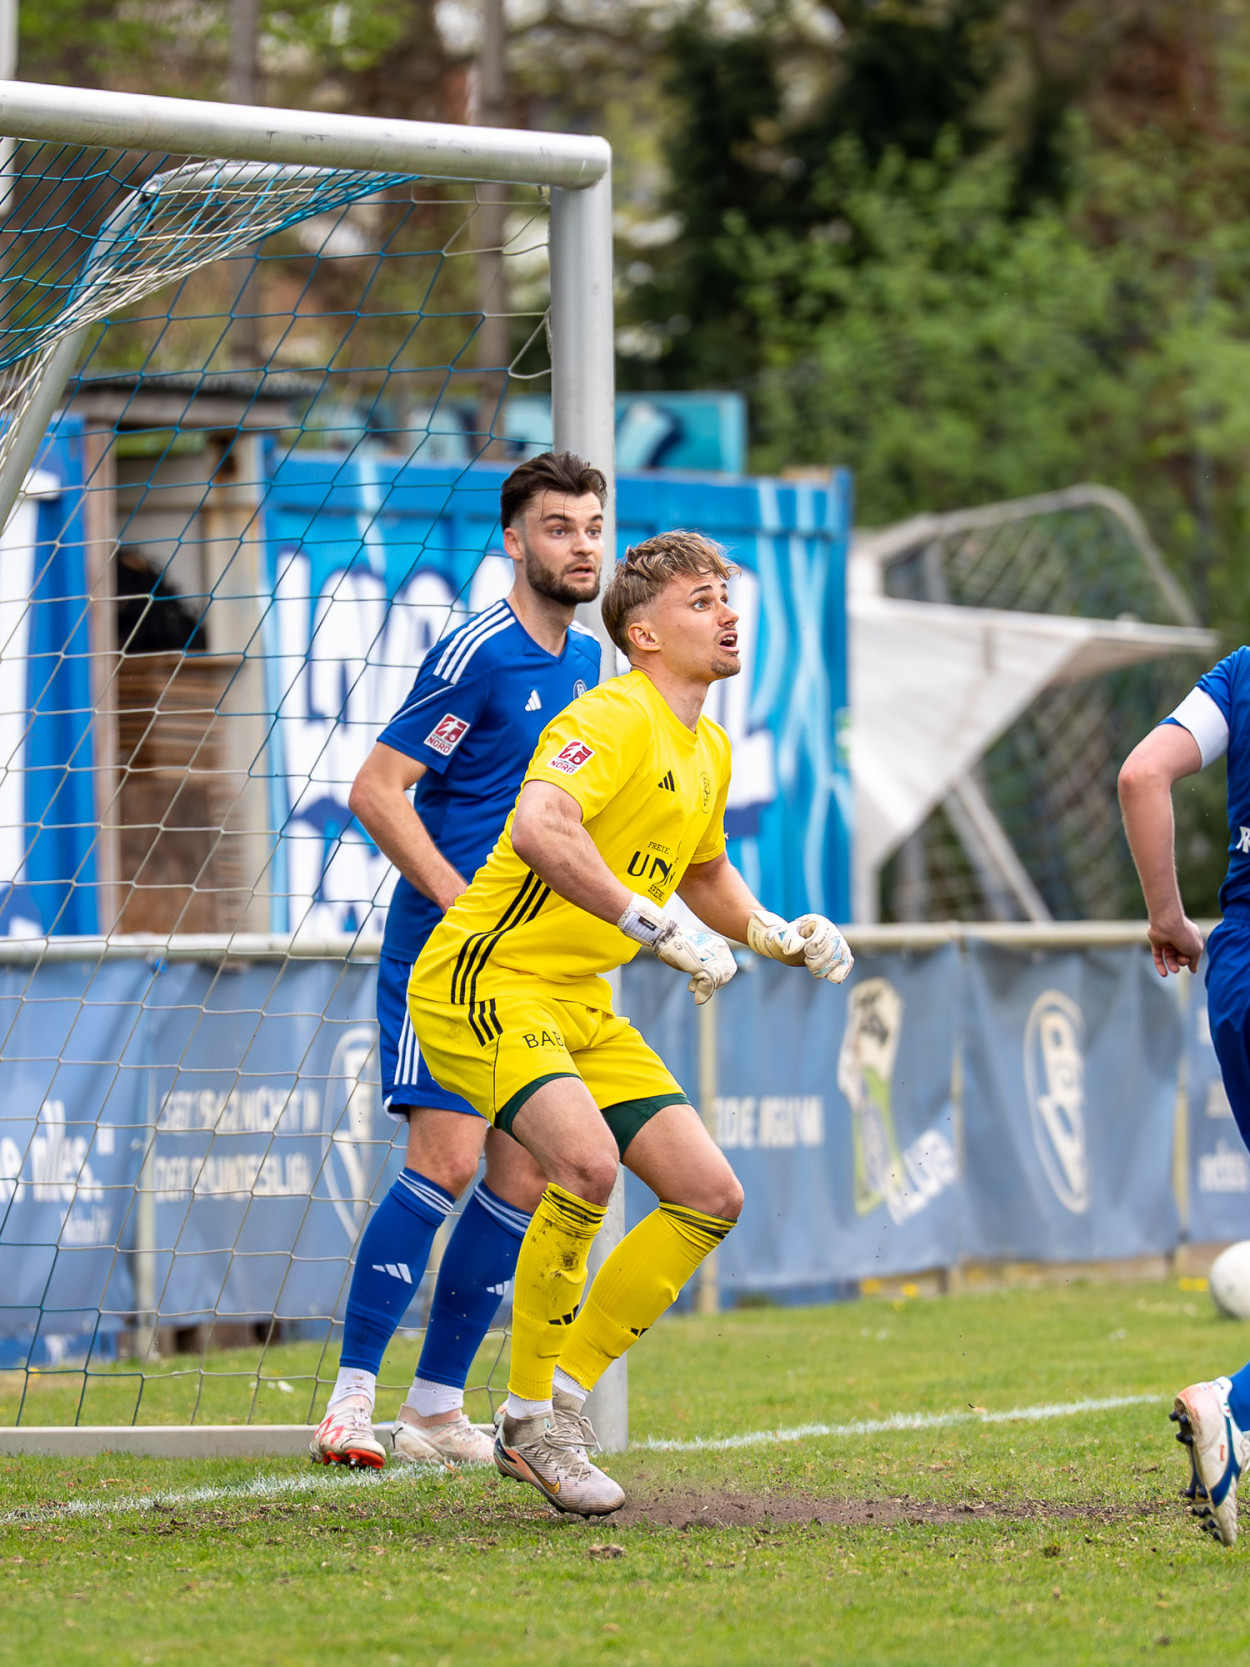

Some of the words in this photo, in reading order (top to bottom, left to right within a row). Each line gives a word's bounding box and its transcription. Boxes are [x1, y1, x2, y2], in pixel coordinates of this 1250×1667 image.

[426, 736, 451, 754] NORD
[550, 760, 575, 774] NORD
[648, 841, 670, 854] FREIE
